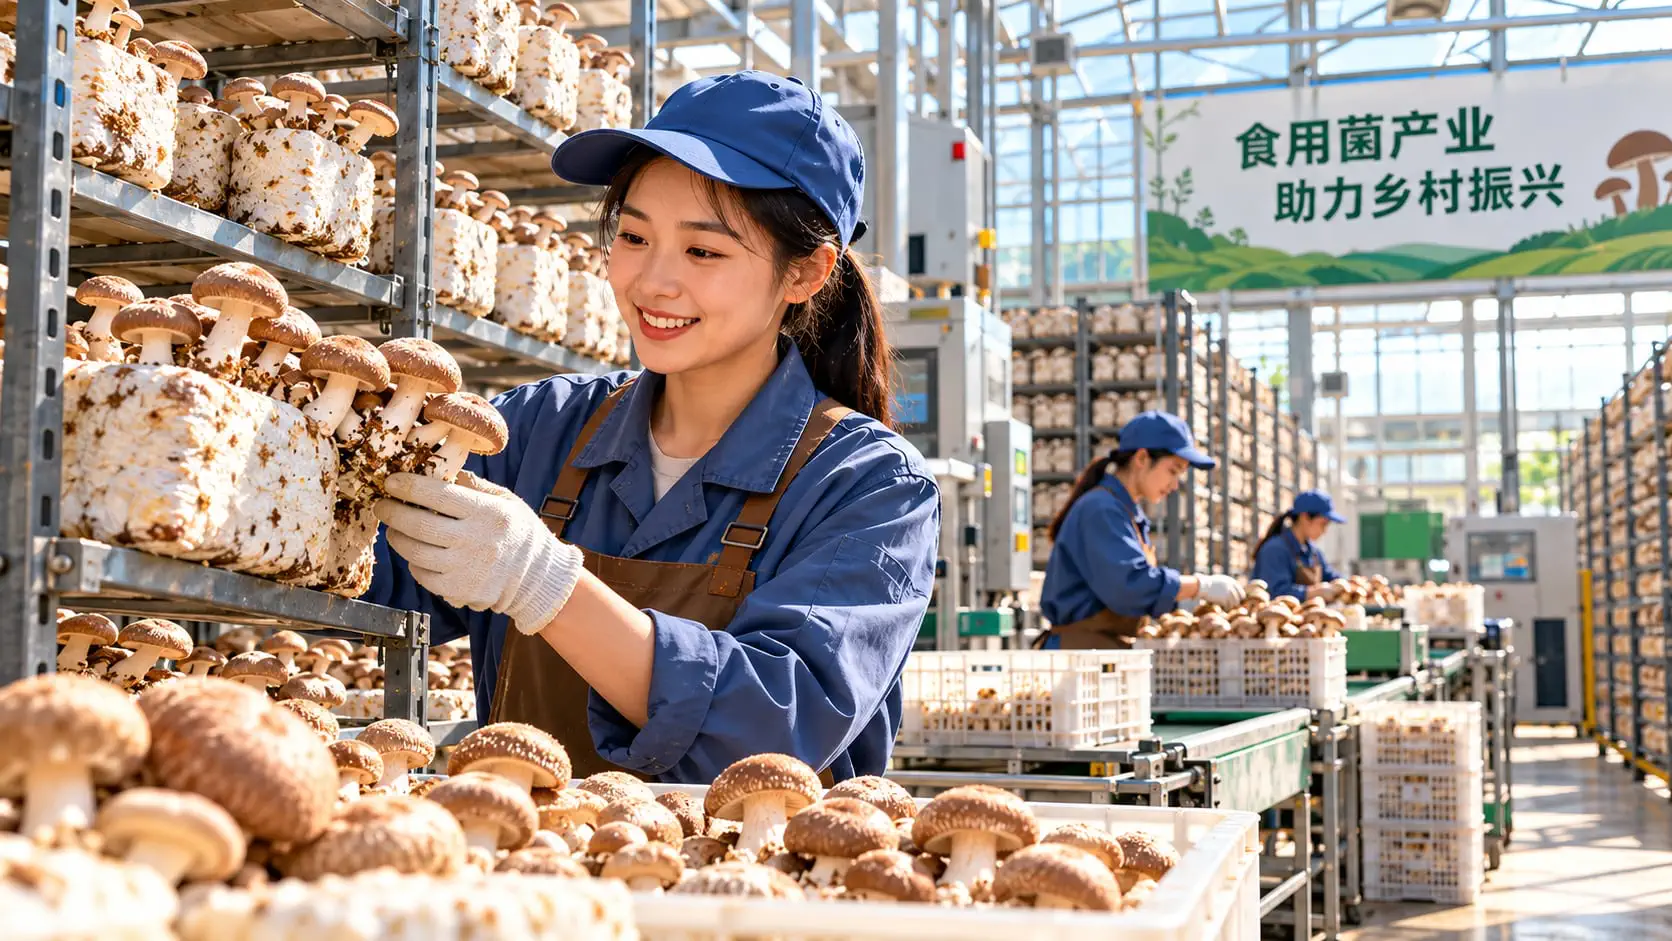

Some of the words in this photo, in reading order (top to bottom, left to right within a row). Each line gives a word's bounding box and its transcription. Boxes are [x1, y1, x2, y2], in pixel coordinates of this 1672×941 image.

[1235, 106, 1495, 170] 食用菌产业
[1274, 163, 1565, 223] 助力乡村振兴
